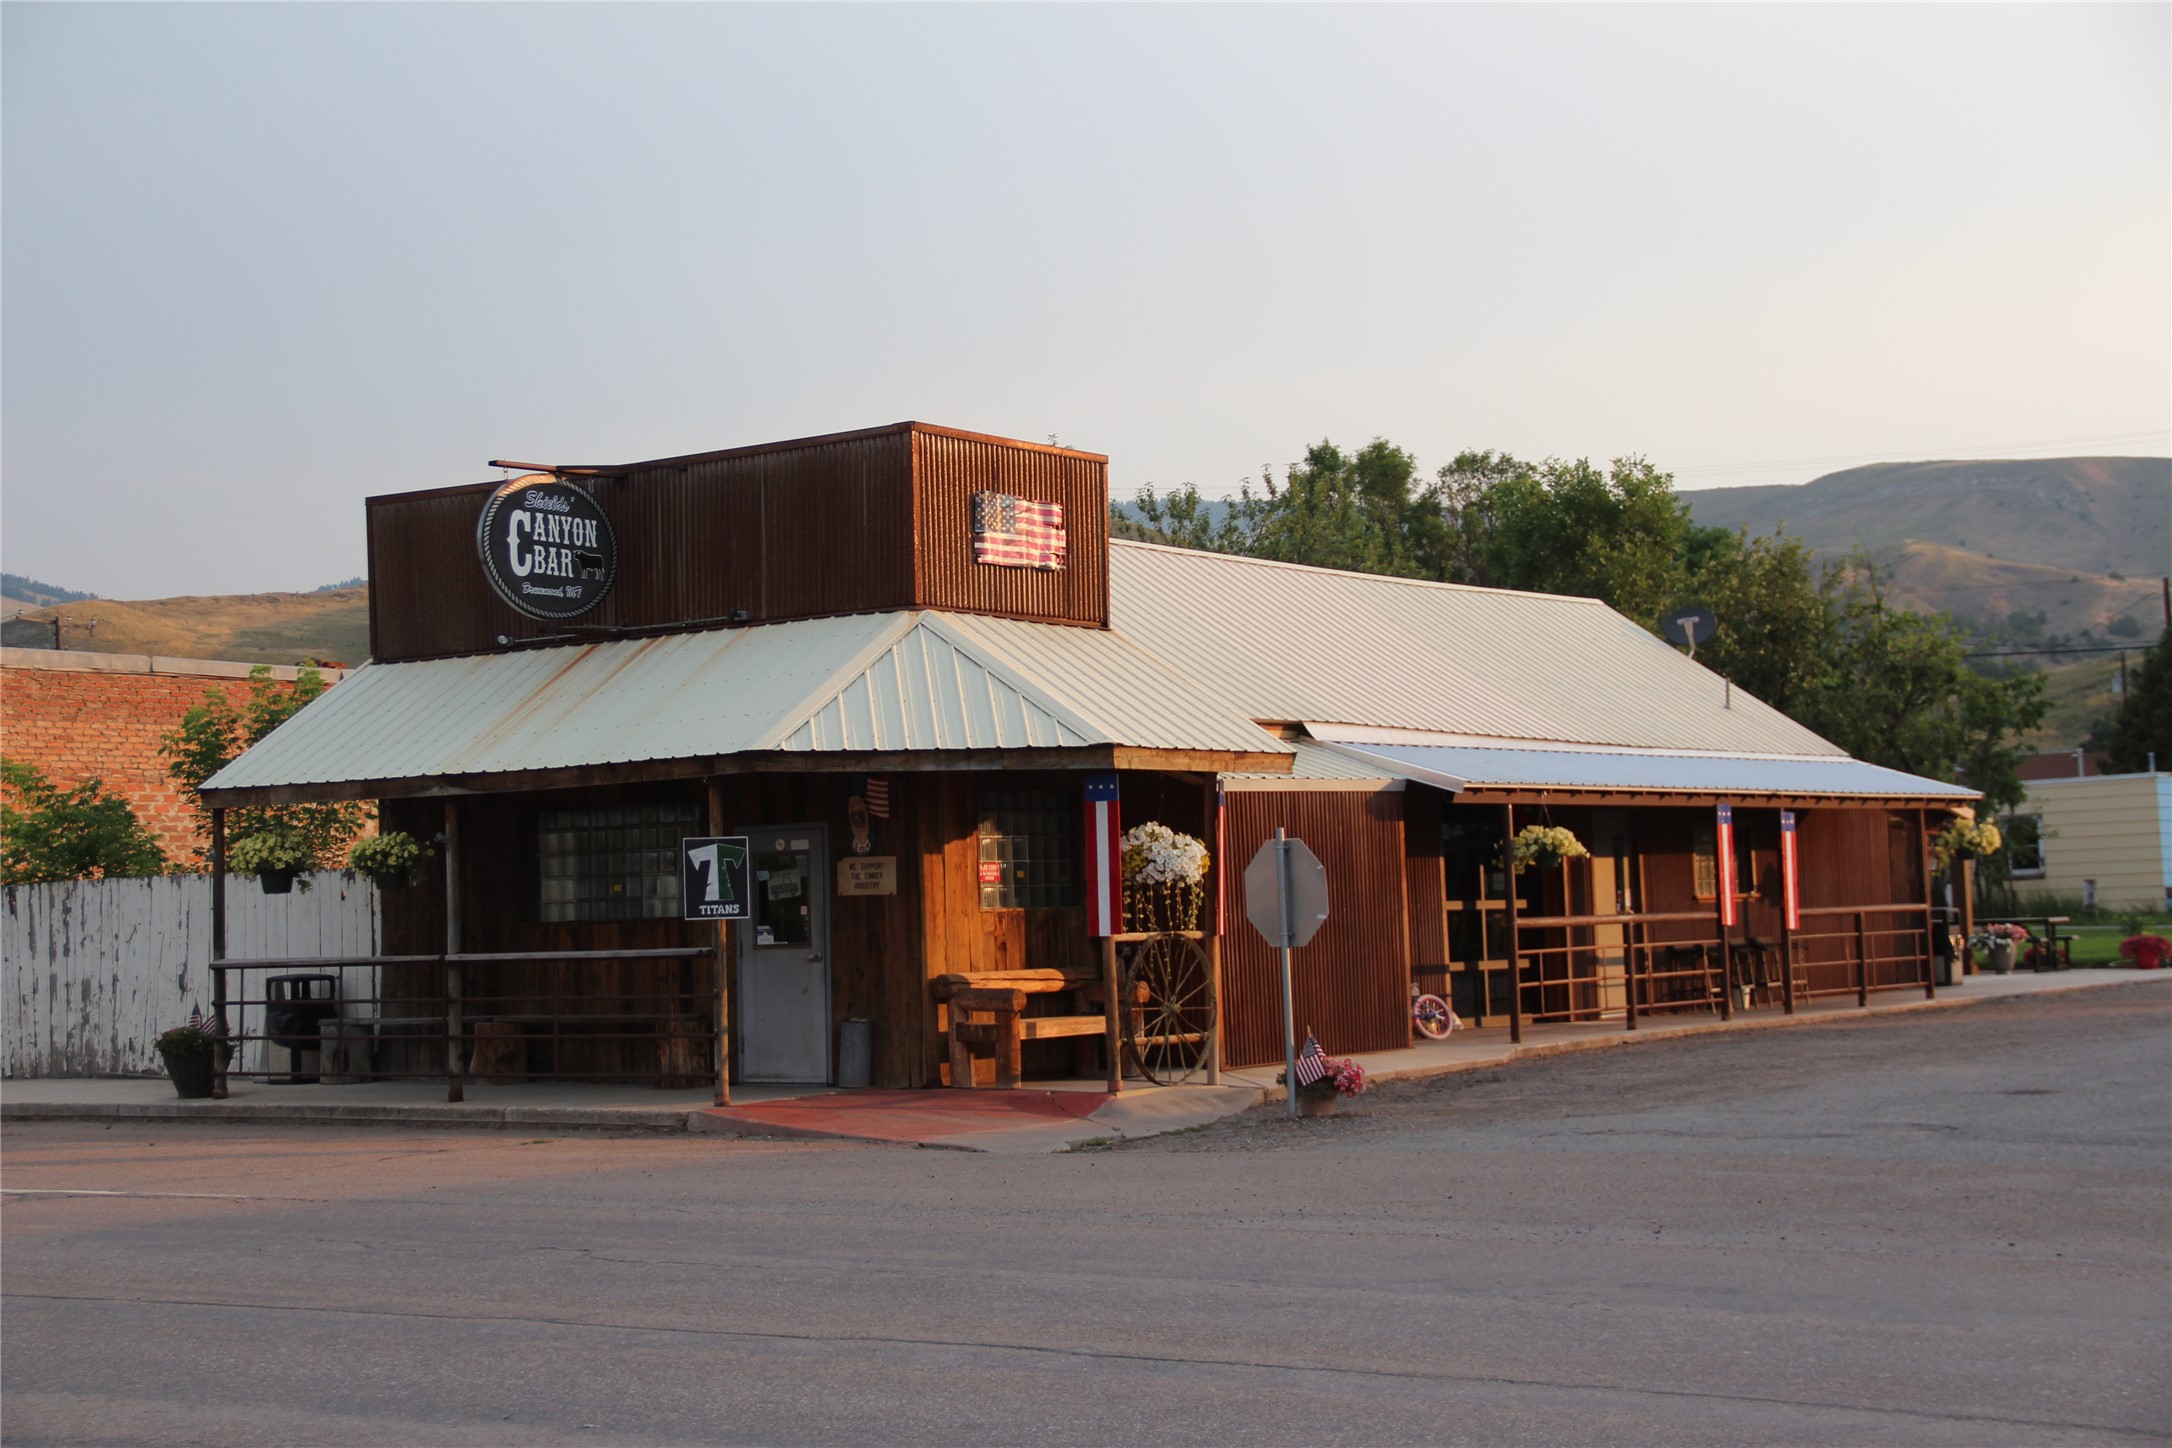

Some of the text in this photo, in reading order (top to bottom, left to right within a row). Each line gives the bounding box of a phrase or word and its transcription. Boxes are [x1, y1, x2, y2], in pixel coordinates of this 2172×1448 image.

[524, 490, 576, 513] Shields'
[506, 509, 598, 577] CANYON
[533, 545, 574, 578] BAR
[861, 862, 885, 870] SUPPORT
[699, 904, 740, 915] TITANS
